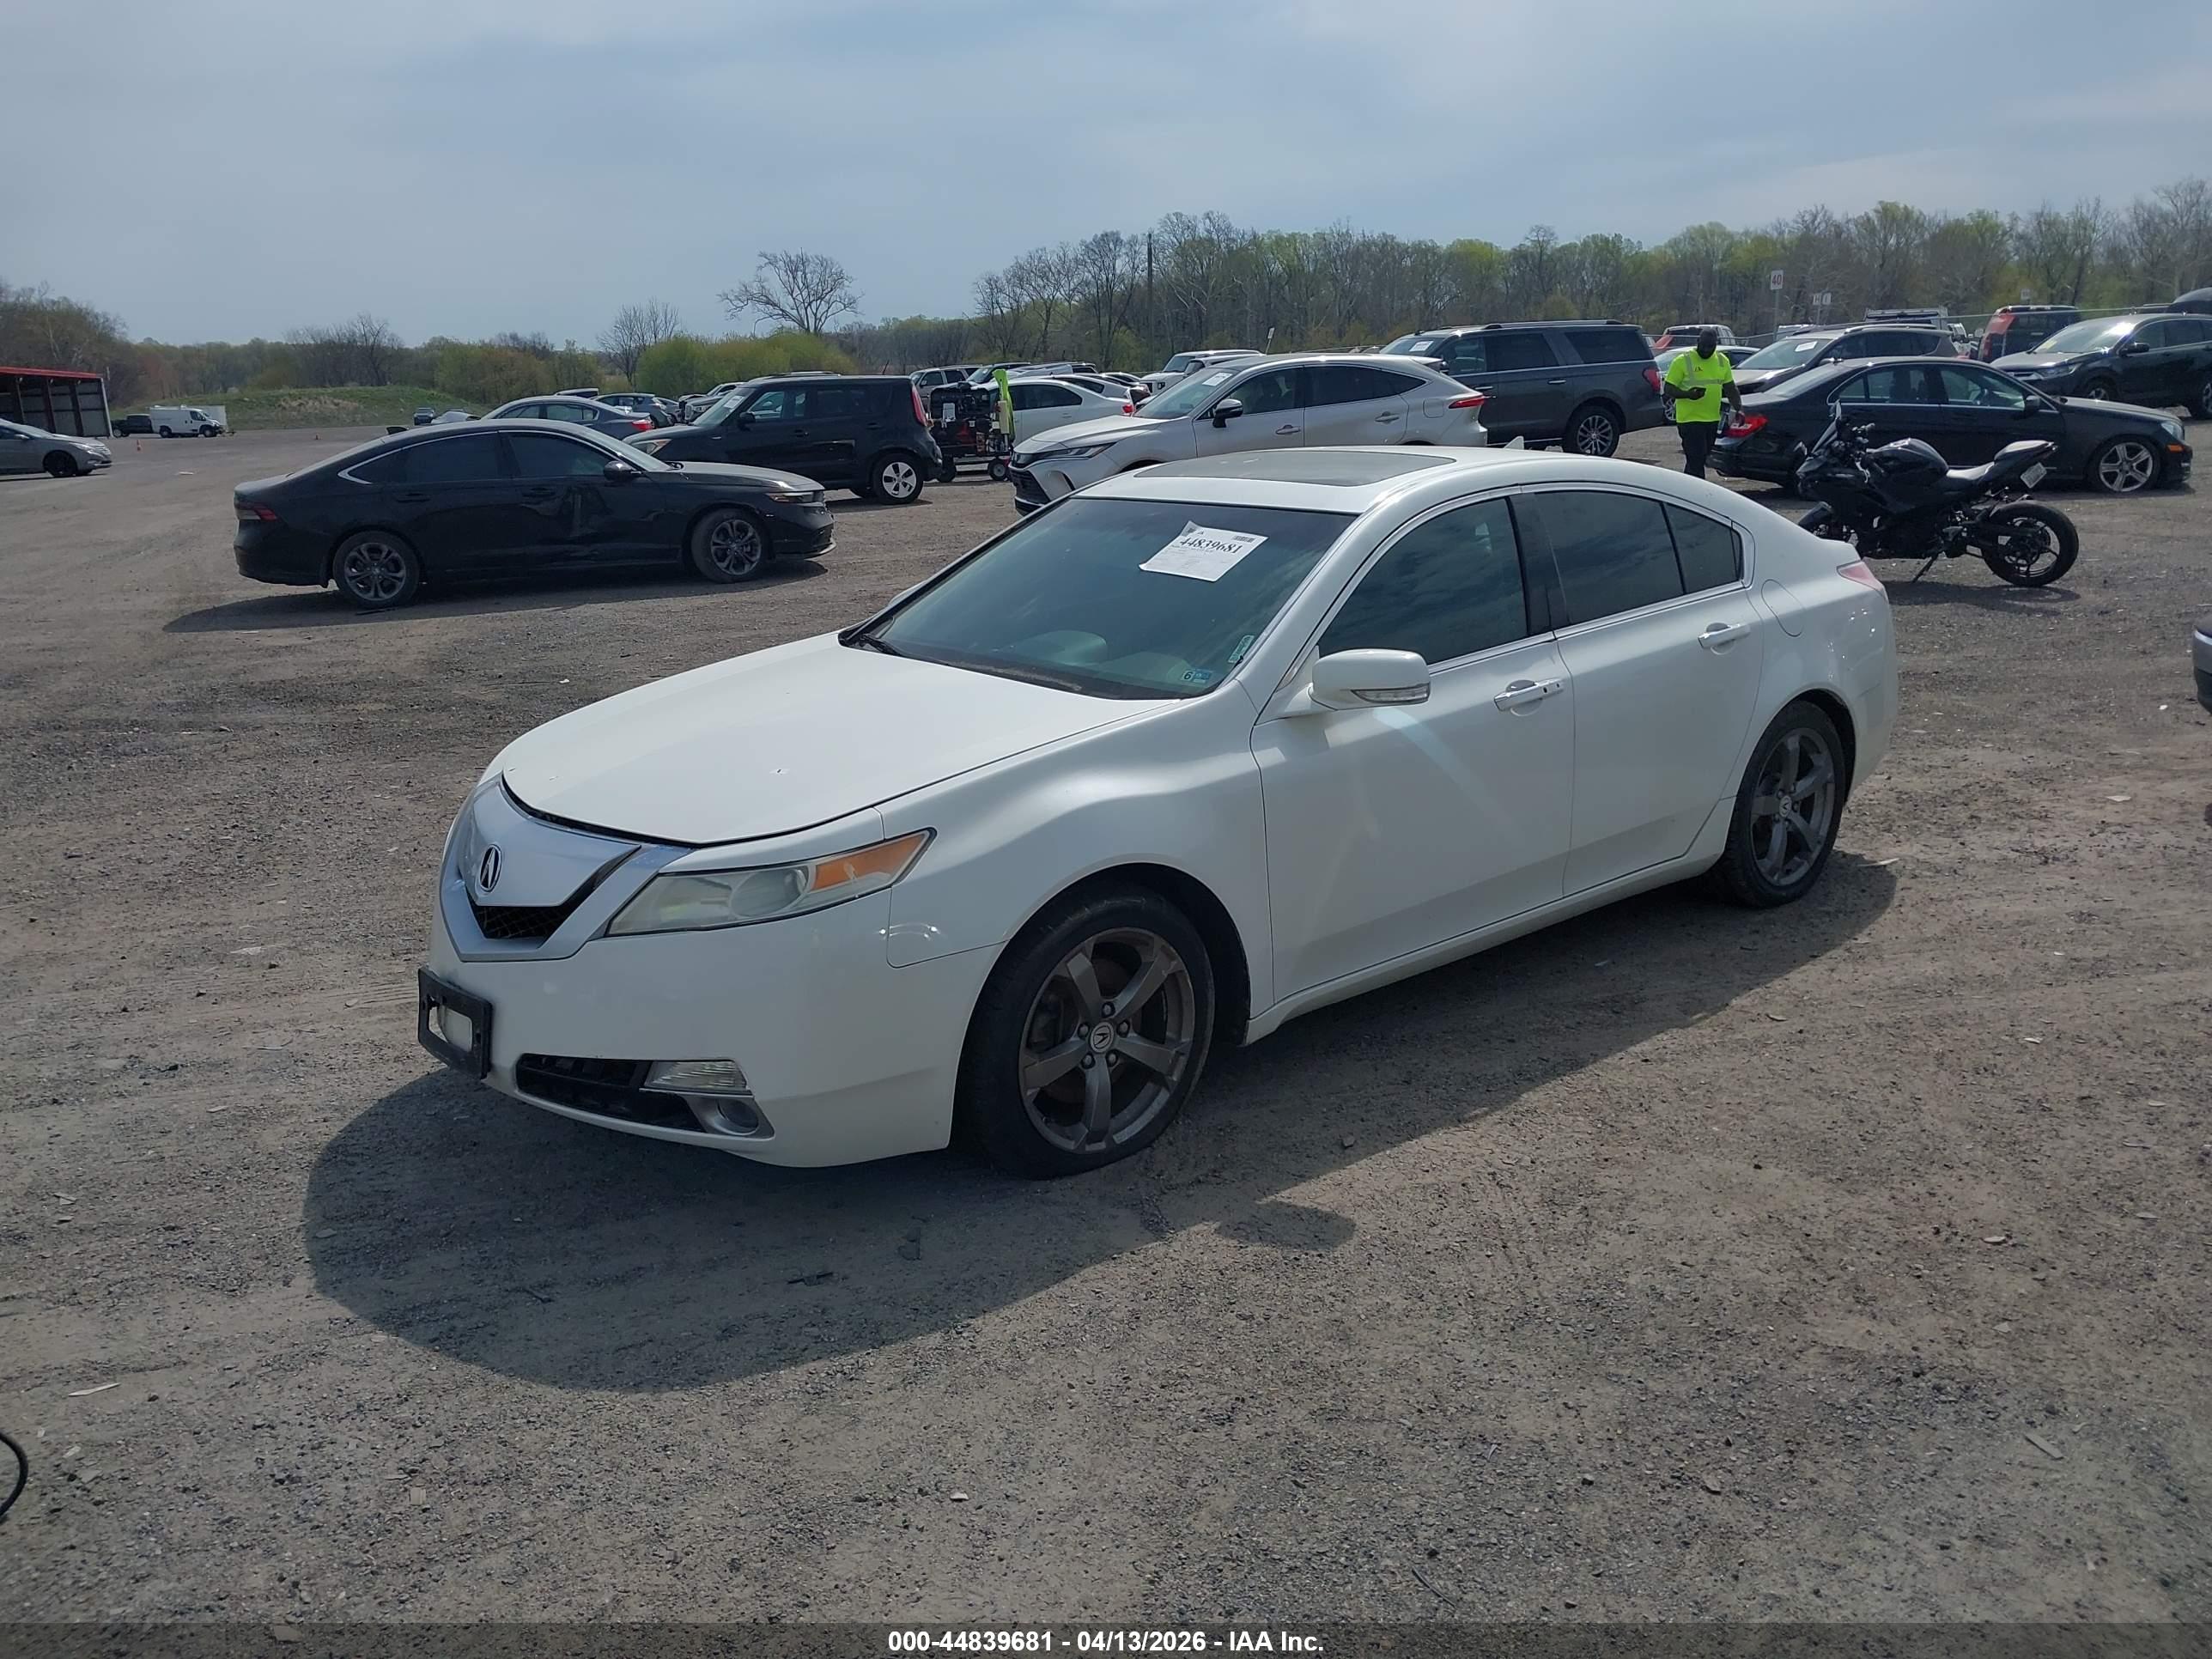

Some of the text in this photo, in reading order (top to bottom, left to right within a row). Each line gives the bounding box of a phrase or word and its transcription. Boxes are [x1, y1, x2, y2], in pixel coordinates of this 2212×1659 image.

[1771, 274, 1783, 285] 40
[1180, 537, 1243, 554] 44839681
[1184, 672, 1193, 680] 6
